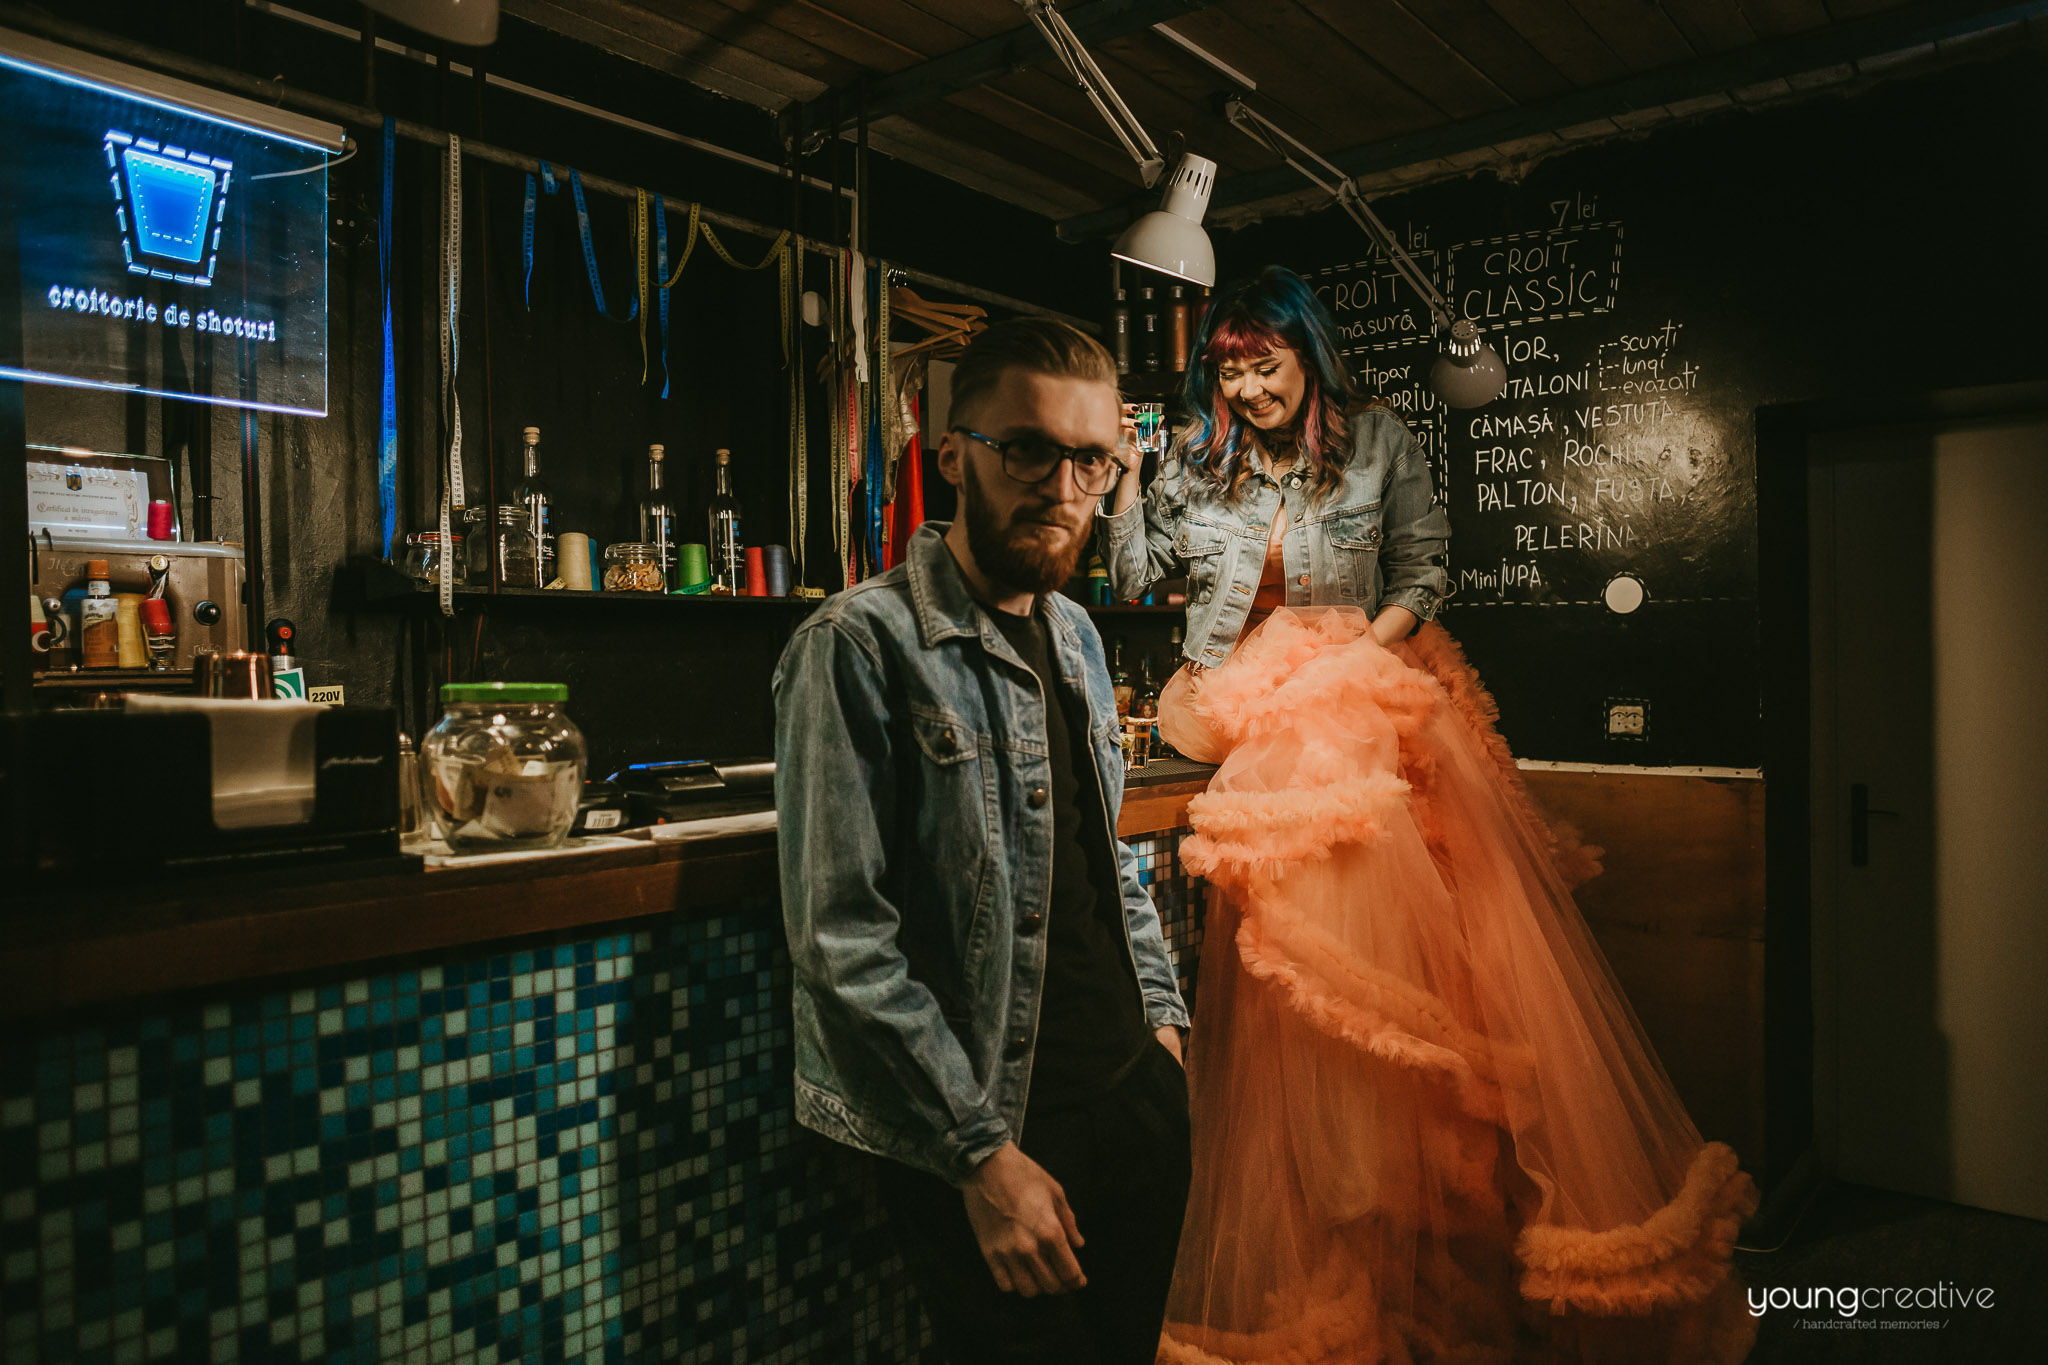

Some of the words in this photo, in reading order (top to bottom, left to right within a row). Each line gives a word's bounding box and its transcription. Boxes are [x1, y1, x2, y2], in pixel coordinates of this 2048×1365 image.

[1577, 191, 1598, 220] lei
[1408, 220, 1430, 250] lei
[1463, 263, 1598, 321] CLASSIC
[47, 284, 158, 323] croitorie
[163, 303, 191, 329] de
[196, 309, 277, 342] shoturi
[1359, 358, 1411, 394] tipar
[312, 690, 341, 703] 220V
